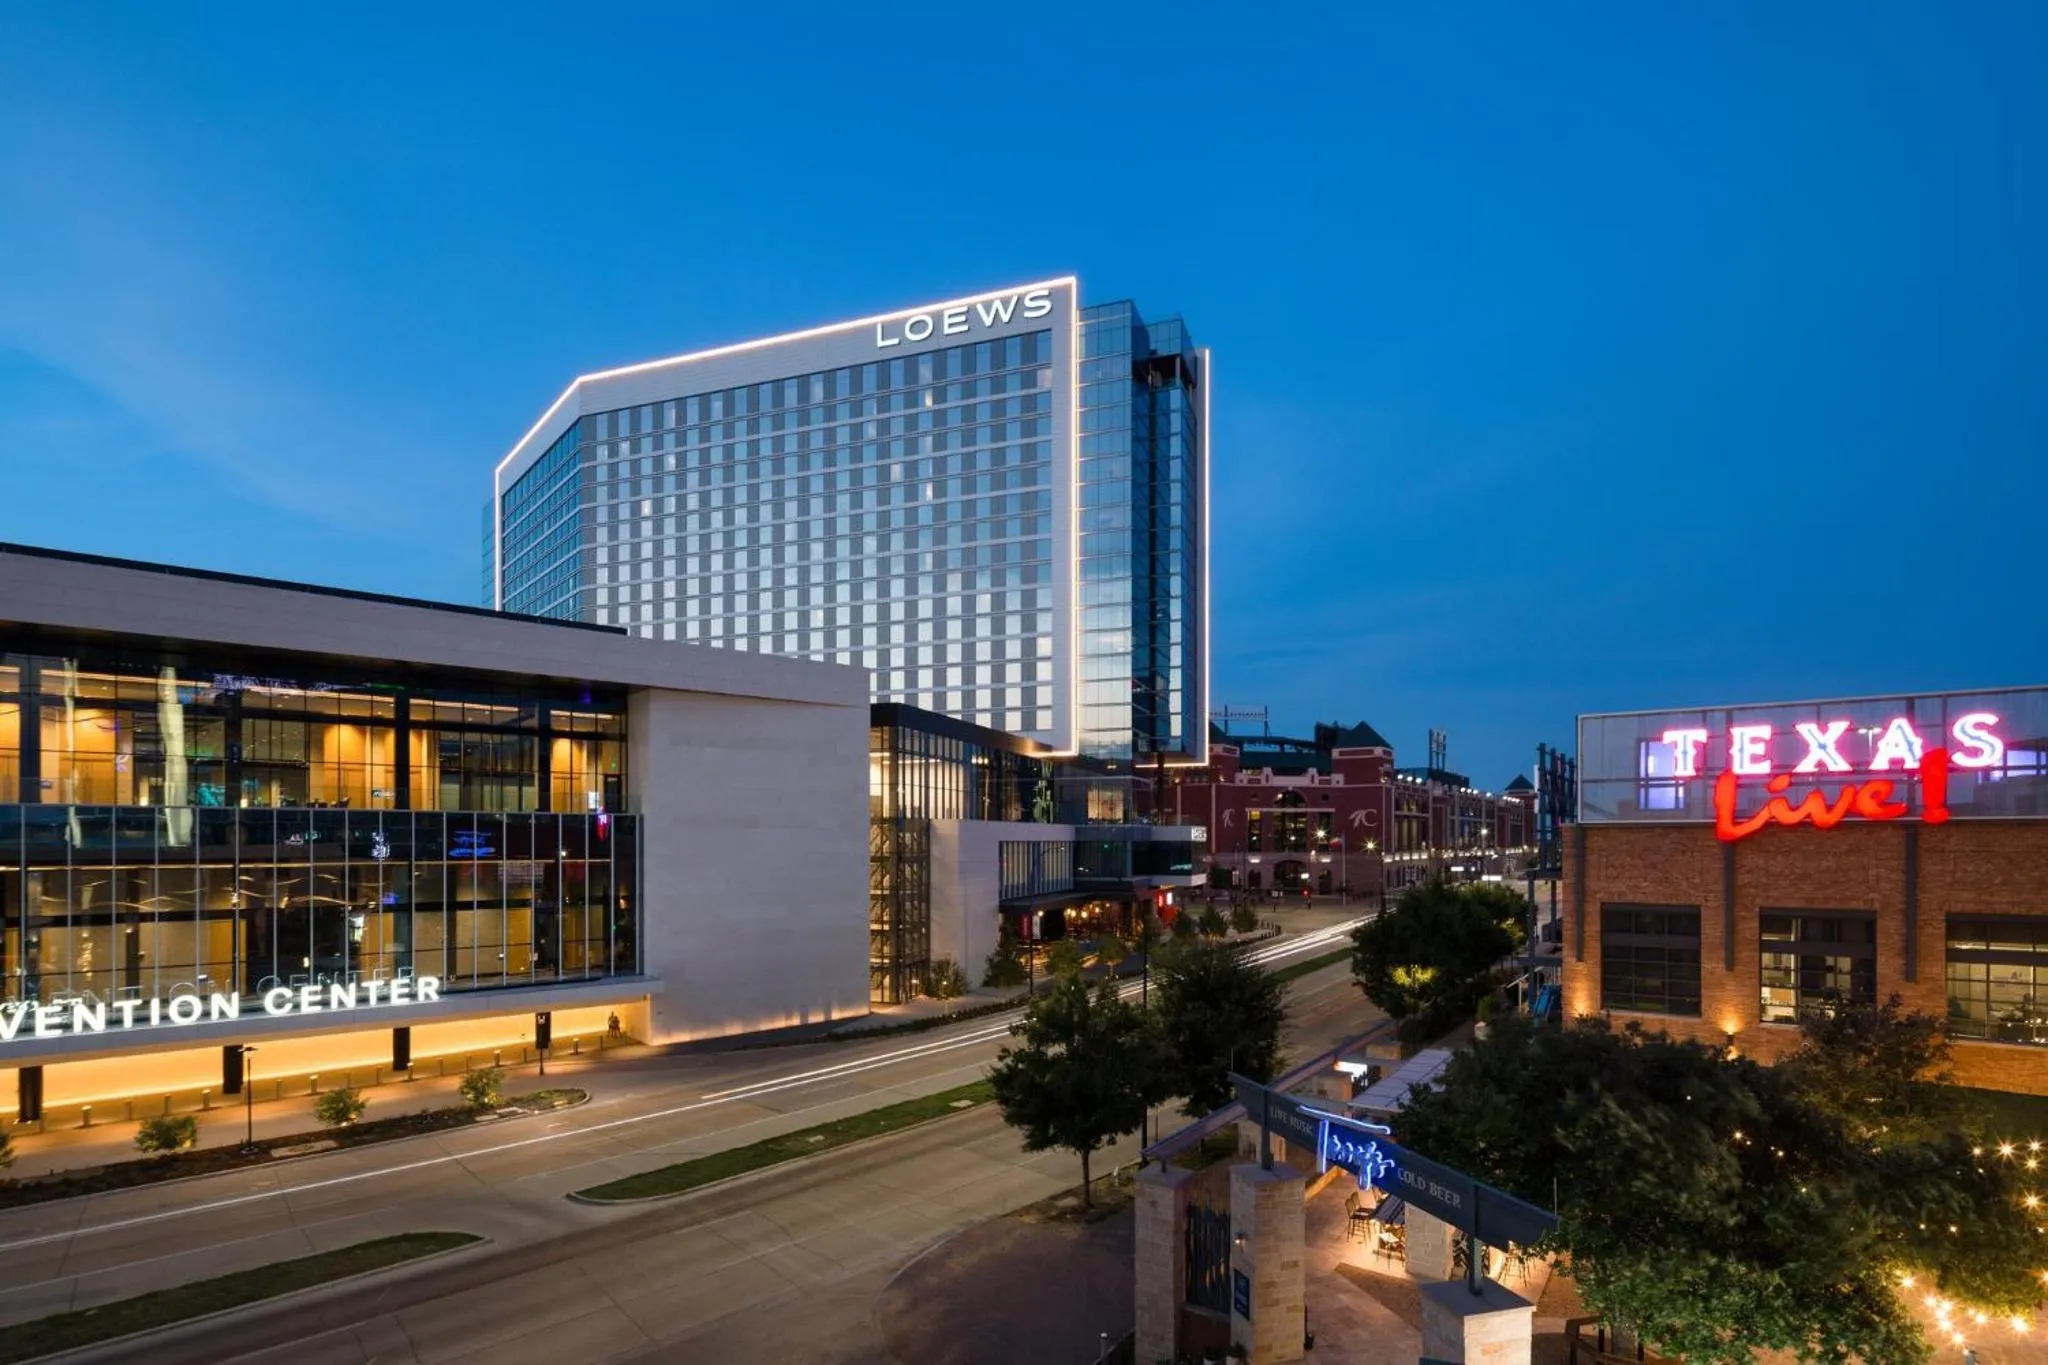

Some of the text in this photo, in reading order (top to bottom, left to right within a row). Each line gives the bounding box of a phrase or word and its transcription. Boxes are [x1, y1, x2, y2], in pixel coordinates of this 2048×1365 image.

[876, 289, 1053, 349] LOEWS
[1662, 712, 2004, 777] TEXAS
[1713, 748, 1950, 842] Live!
[0, 975, 440, 1041] VENTION CENTER
[1396, 1167, 1463, 1210] COLD BEER
